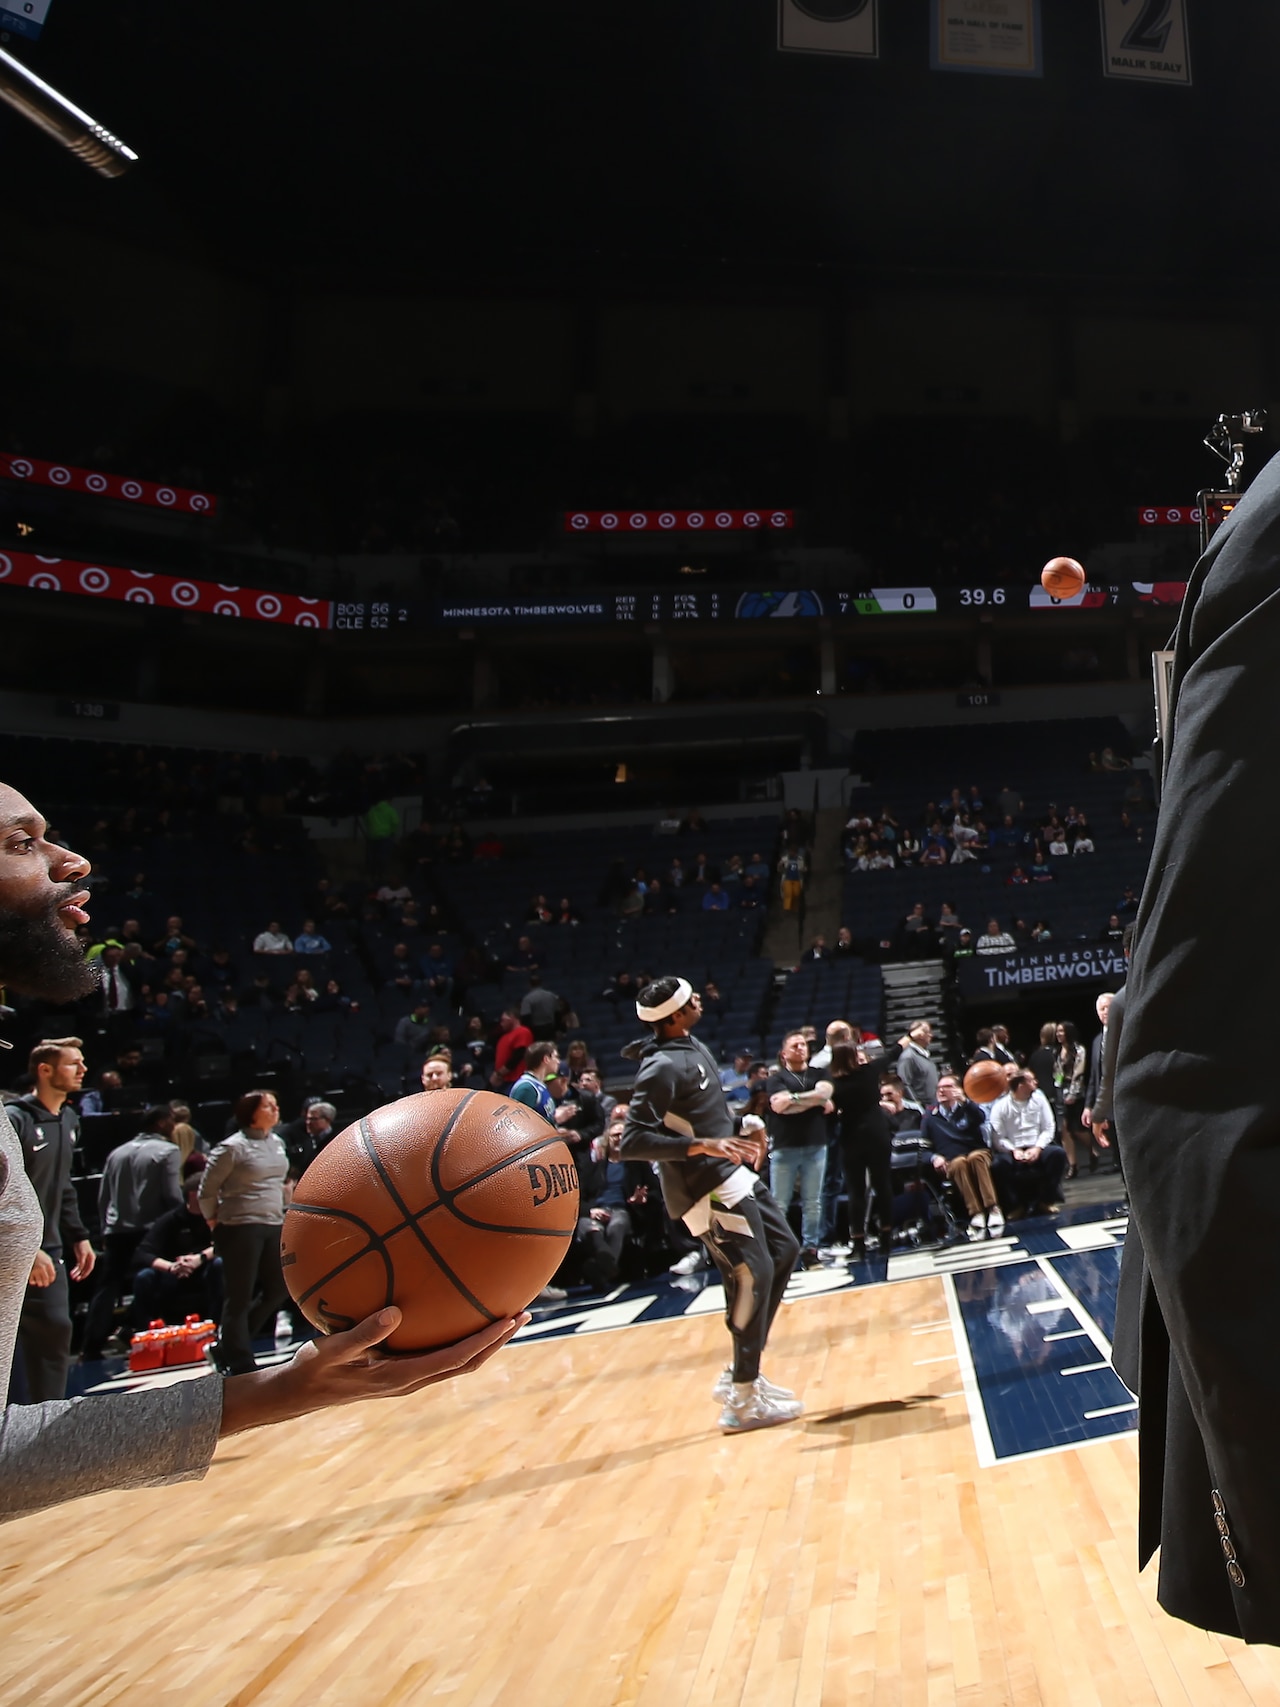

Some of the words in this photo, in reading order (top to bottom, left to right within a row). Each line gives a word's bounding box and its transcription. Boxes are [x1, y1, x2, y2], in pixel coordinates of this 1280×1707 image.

[1111, 56, 1146, 69] MALIK
[1150, 60, 1182, 72] SEALY
[903, 594, 915, 608] 0
[959, 589, 1006, 606] 39.6
[1111, 595, 1118, 605] 7
[337, 603, 365, 616] BOS
[371, 602, 389, 615] 56
[443, 606, 510, 617] MINNESOTA
[514, 604, 603, 615] TIMBERWOLVES
[840, 602, 847, 613] 7
[397, 608, 407, 622] 2
[336, 616, 364, 630] CLE
[370, 616, 389, 629] 52
[968, 695, 988, 705] 101
[1006, 948, 1116, 968] MINNESOTA
